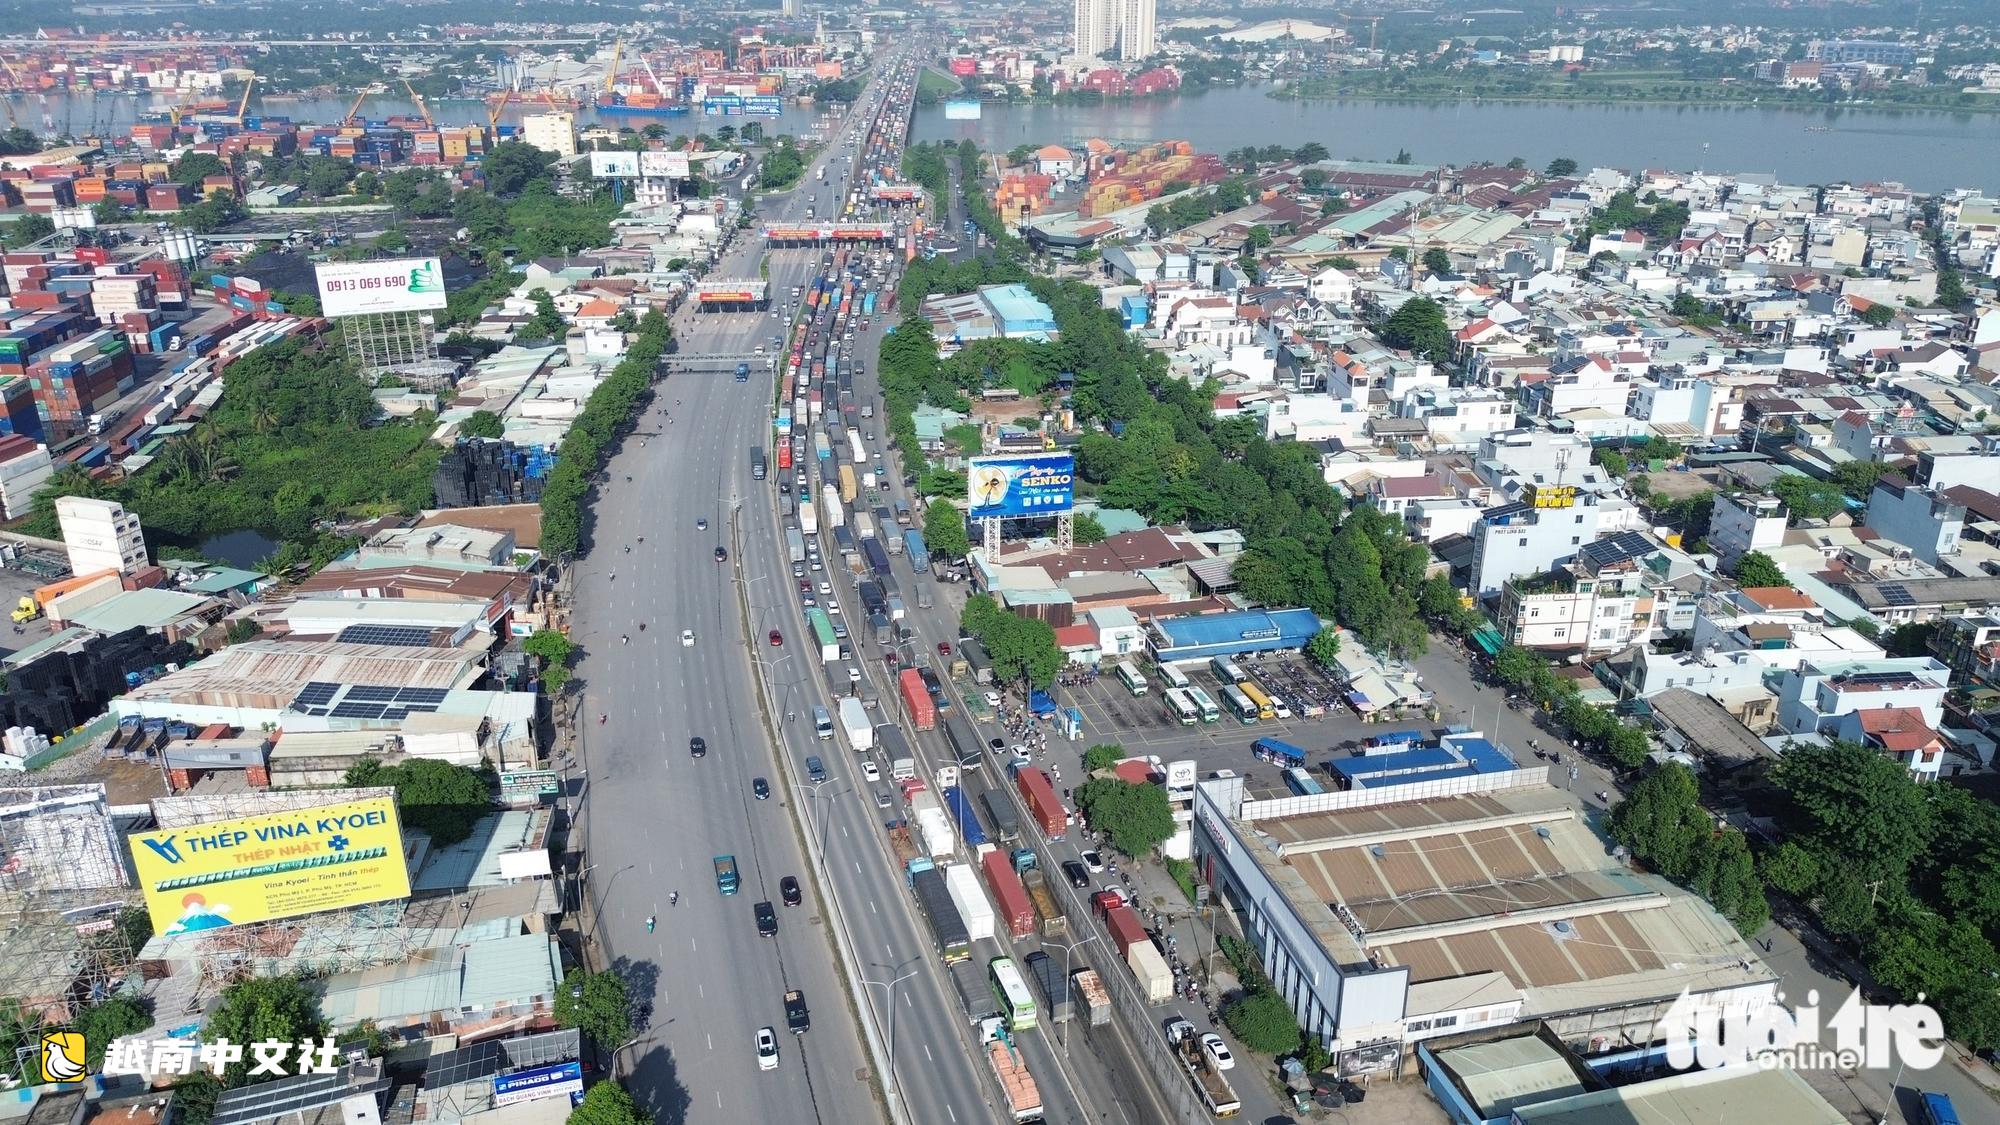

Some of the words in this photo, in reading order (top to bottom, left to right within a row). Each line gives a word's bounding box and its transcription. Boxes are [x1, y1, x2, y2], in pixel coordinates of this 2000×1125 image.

[326, 279, 355, 292] 0913
[360, 277, 380, 289] 069
[385, 275, 406, 288] 690
[1021, 474, 1071, 487] SENKO
[185, 829, 249, 853] THÉP
[254, 822, 311, 842] VINA
[316, 810, 386, 833] KYOEI
[232, 846, 275, 864] THÉP
[278, 840, 321, 858] NHẬT
[264, 880, 282, 889] Vina
[285, 876, 309, 889] Kyoei
[516, 1092, 536, 1100] QUANG
